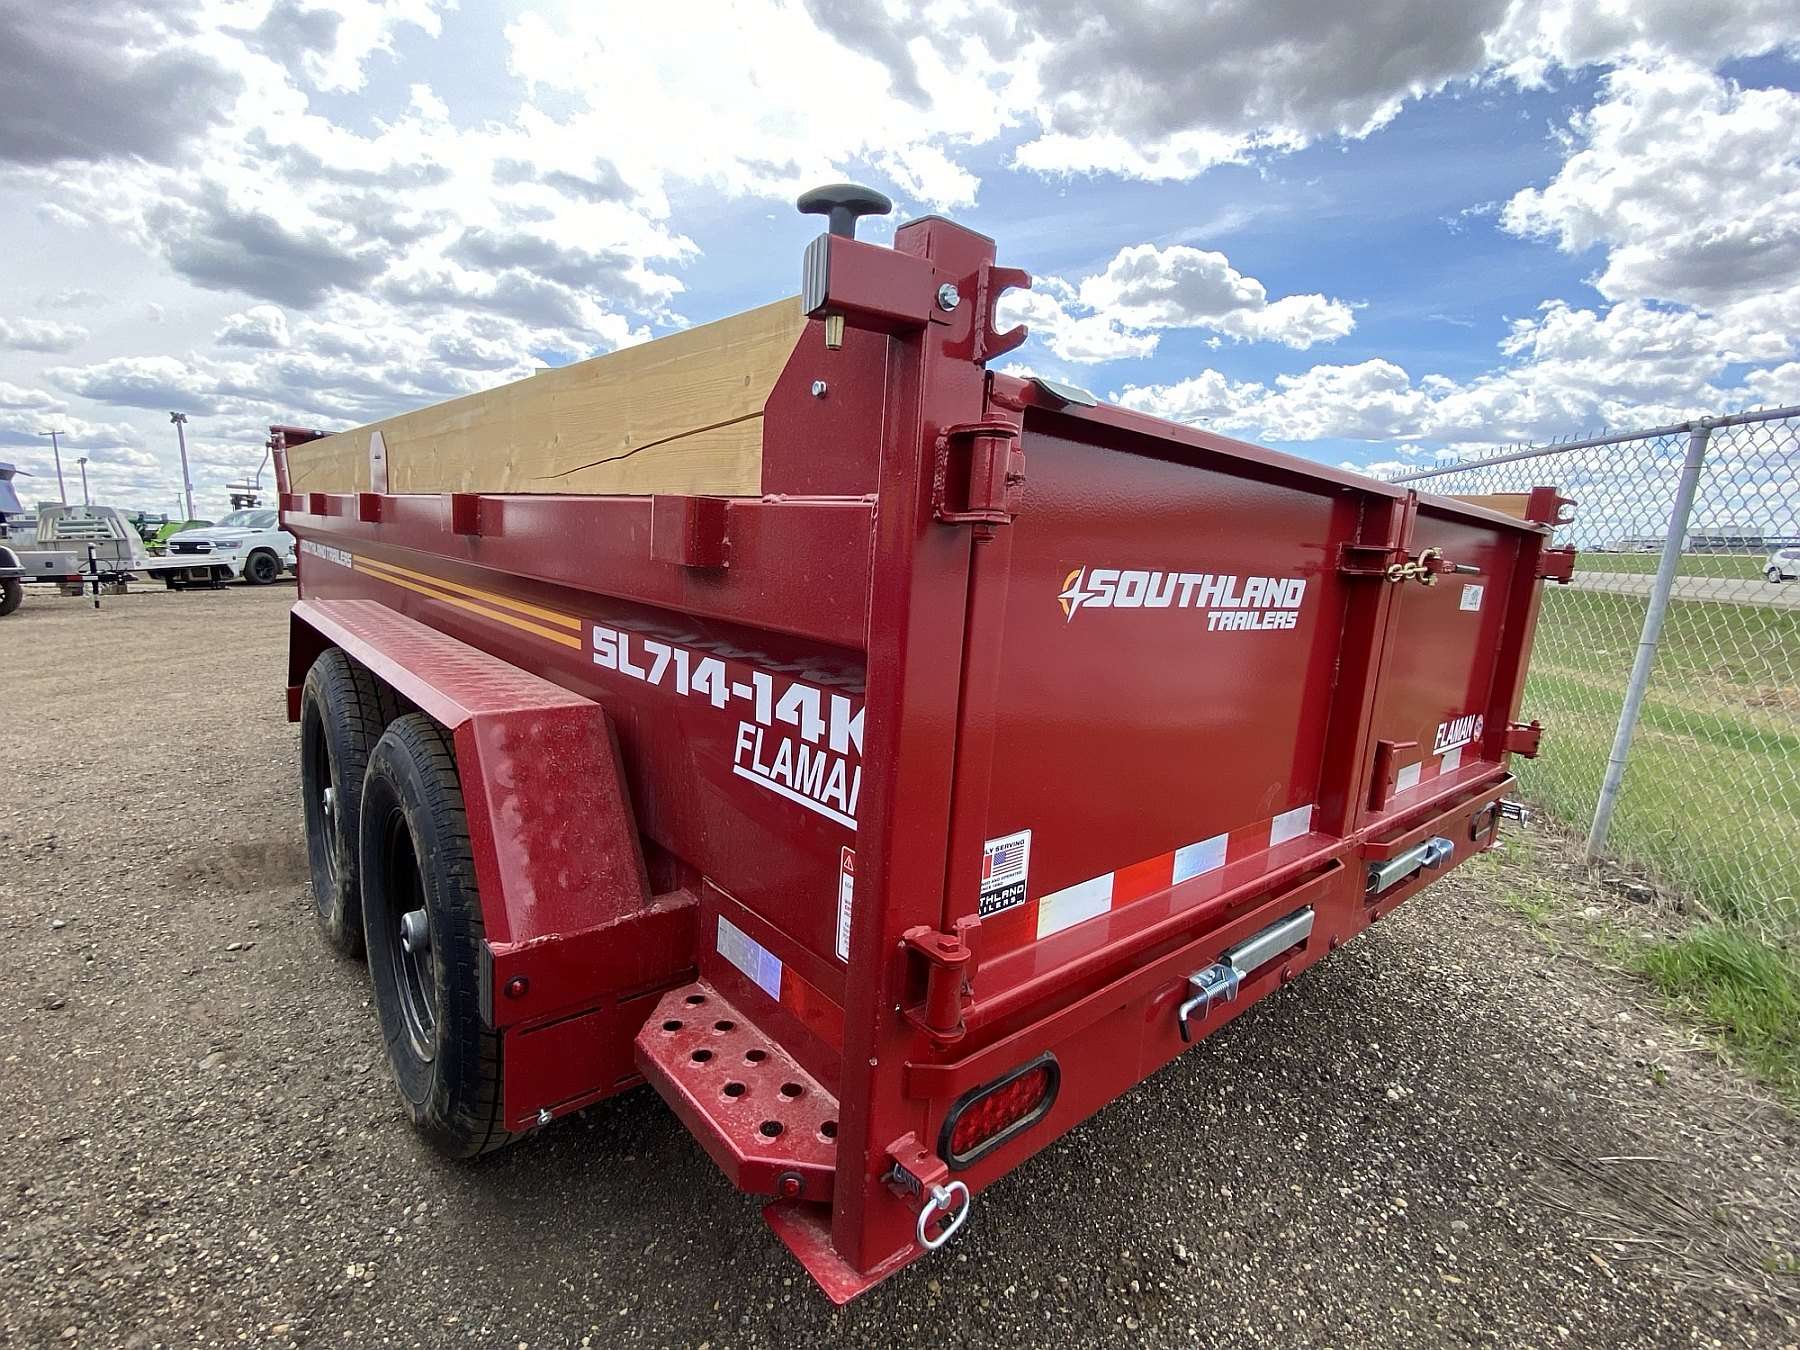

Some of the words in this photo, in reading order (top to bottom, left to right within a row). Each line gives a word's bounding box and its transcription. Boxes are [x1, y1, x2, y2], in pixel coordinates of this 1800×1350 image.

[1082, 568, 1306, 608] SOUTHLAND
[1207, 610, 1298, 631] TRAILERS
[592, 625, 866, 757] SL714-14K
[1433, 713, 1476, 750] FLAMAN
[995, 839, 1025, 853] SERVING
